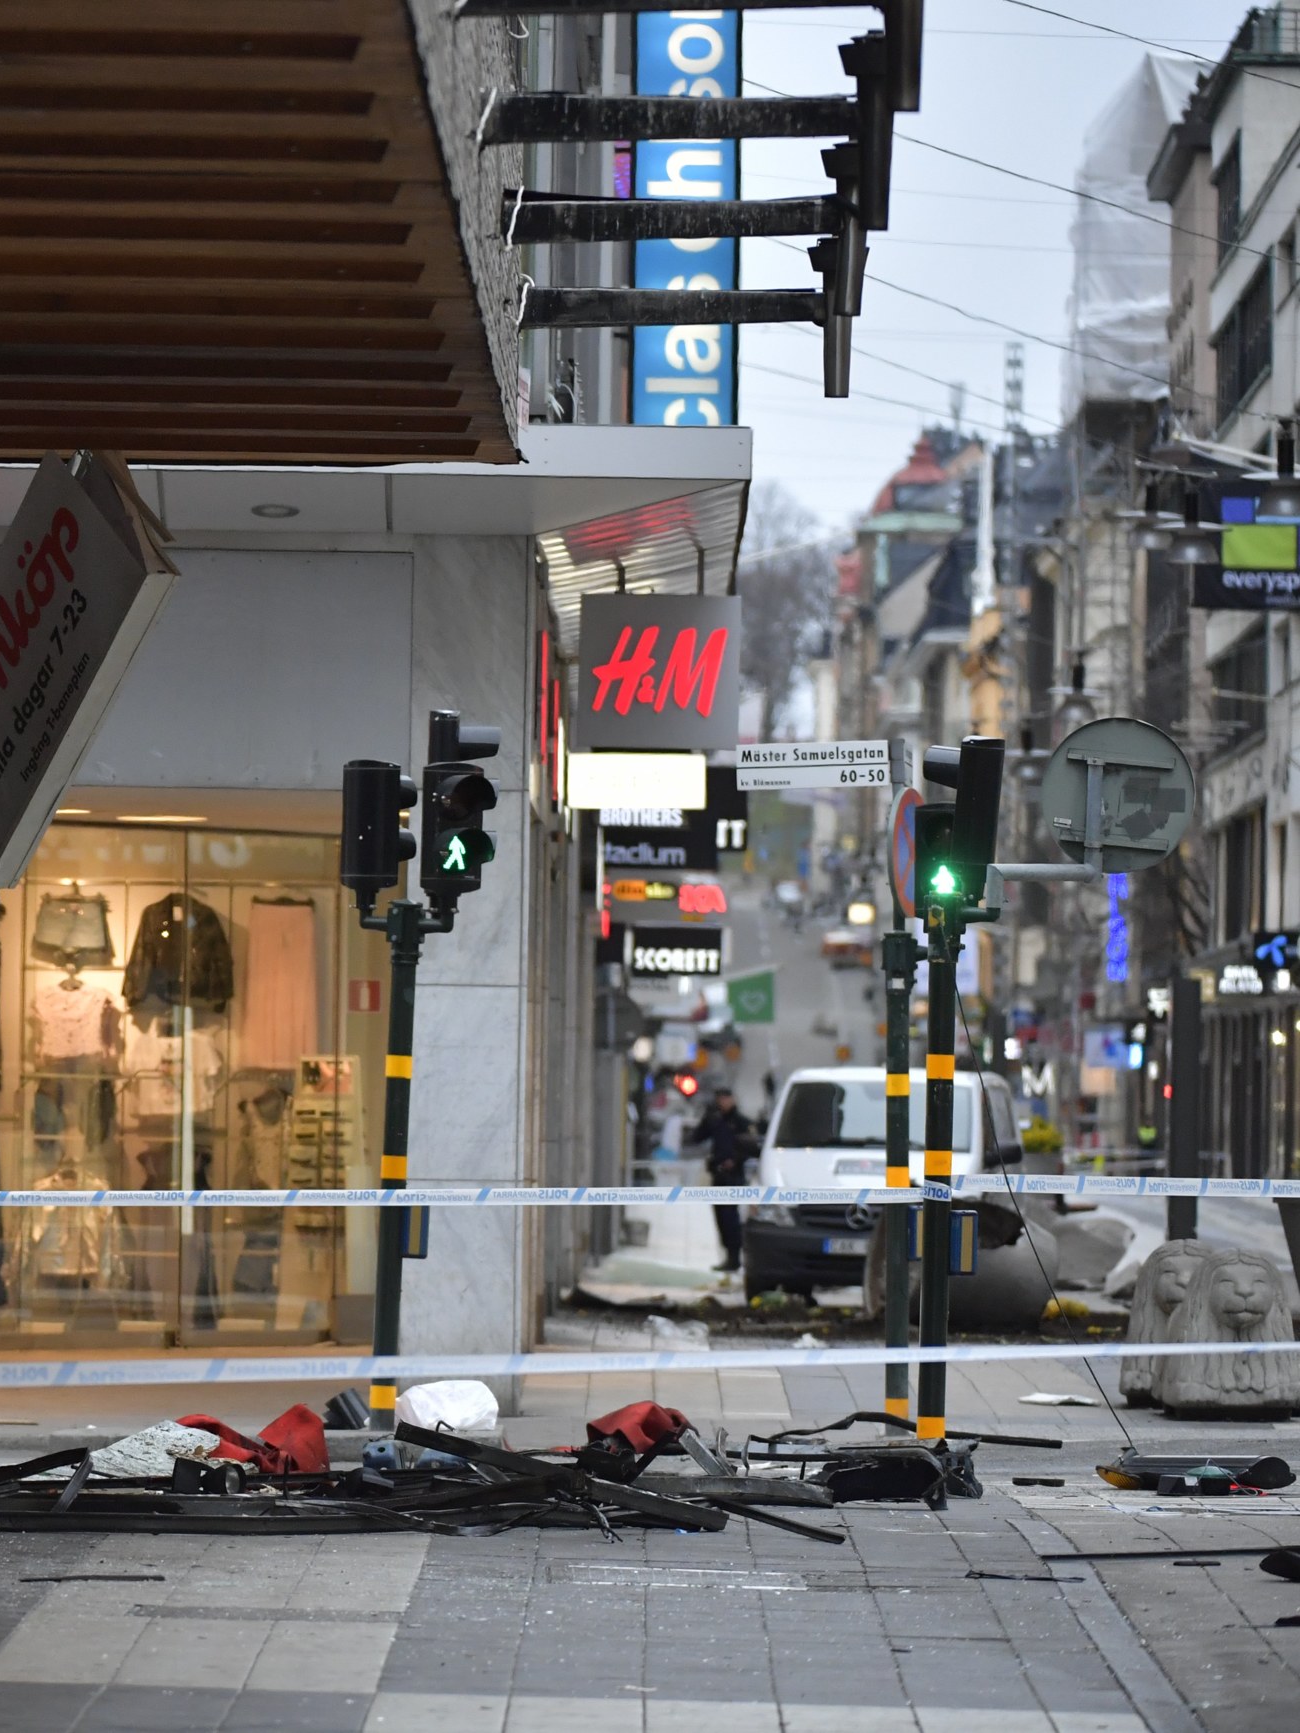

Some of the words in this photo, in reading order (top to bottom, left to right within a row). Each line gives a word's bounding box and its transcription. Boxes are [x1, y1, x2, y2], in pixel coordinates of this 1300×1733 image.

[13, 657, 56, 735] dagar
[51, 588, 89, 655] 7-23
[592, 625, 728, 718] H&M
[19, 734, 51, 782] Ingång
[46, 652, 90, 730] T-baneplan
[741, 749, 787, 763] Mäster
[793, 746, 884, 762] Samuelsgatan
[840, 769, 885, 783] 60-50
[599, 808, 684, 827] BROTHERS
[604, 841, 686, 866] tadium
[924, 1186, 949, 1199] POLIS
